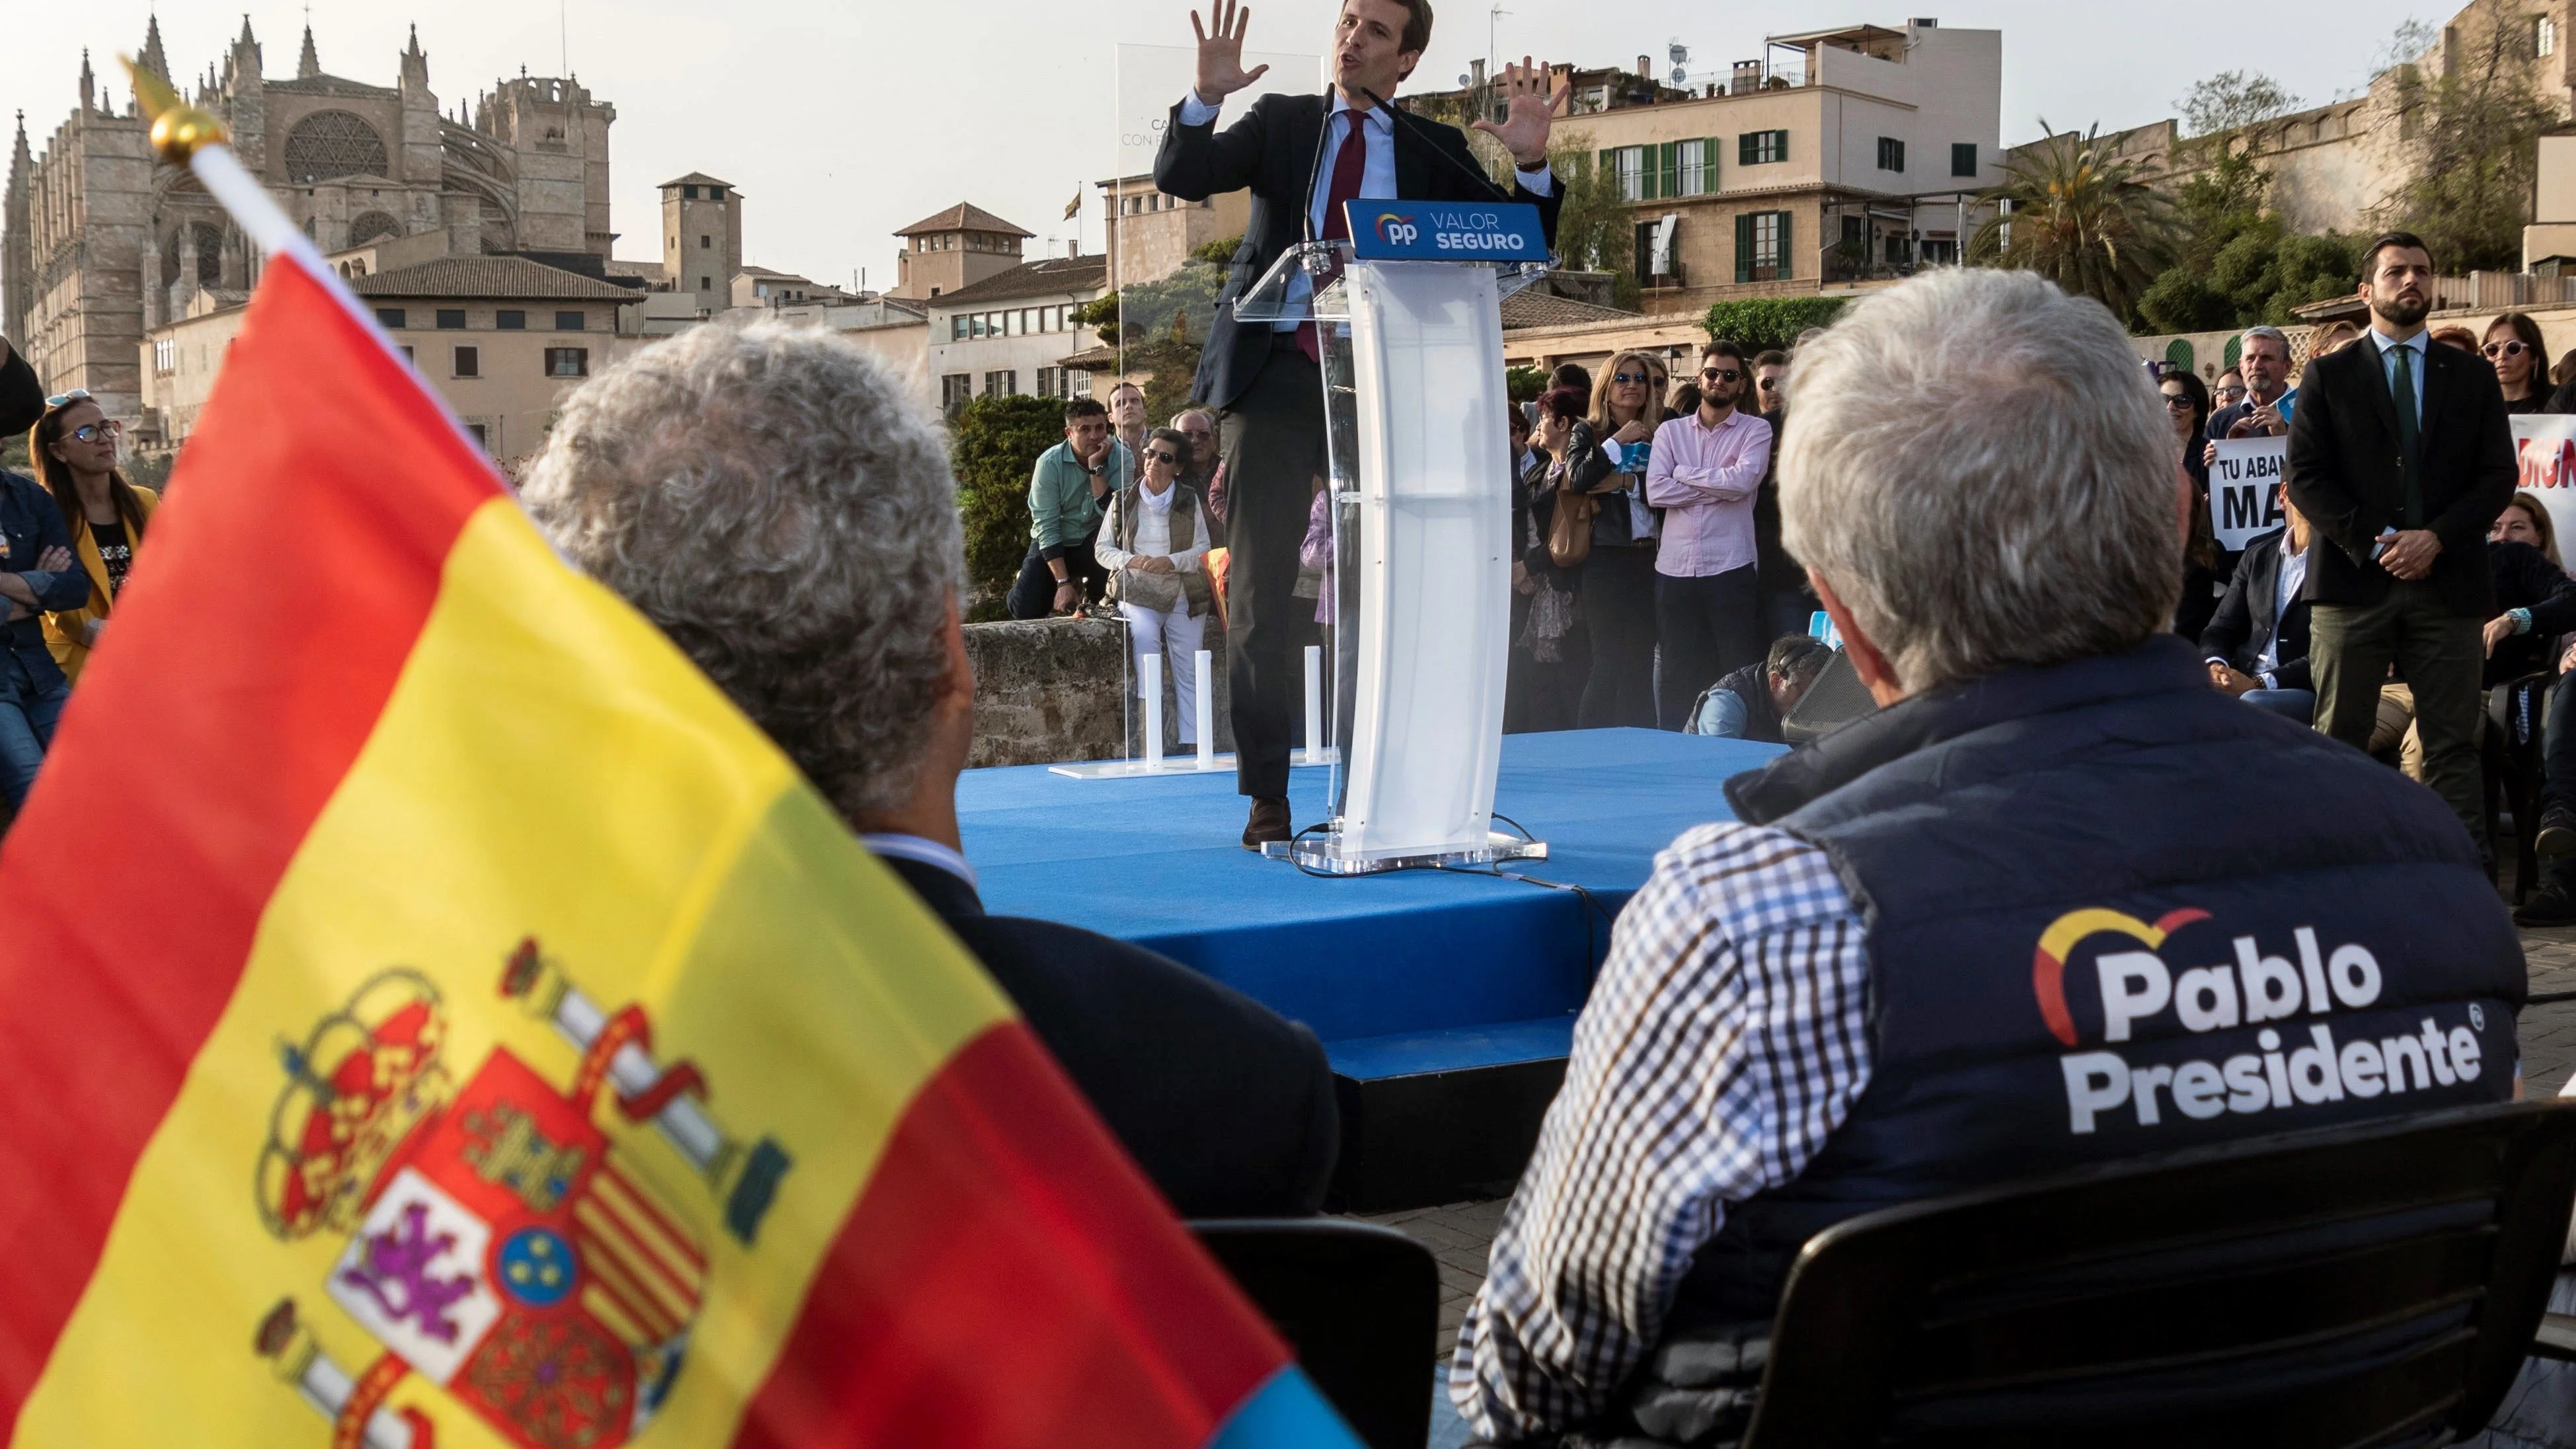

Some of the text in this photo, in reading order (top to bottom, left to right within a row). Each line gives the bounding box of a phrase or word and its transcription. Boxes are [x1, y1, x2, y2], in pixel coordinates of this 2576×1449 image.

[1121, 133, 1152, 146] CON
[1430, 212, 1499, 230] VALOR
[1435, 233, 1524, 250] SEGURO
[2219, 459, 2240, 480] TU
[2222, 483, 2286, 529] MA
[2096, 926, 2383, 1043] Pablo
[2060, 1016, 2483, 1136] Presidente
